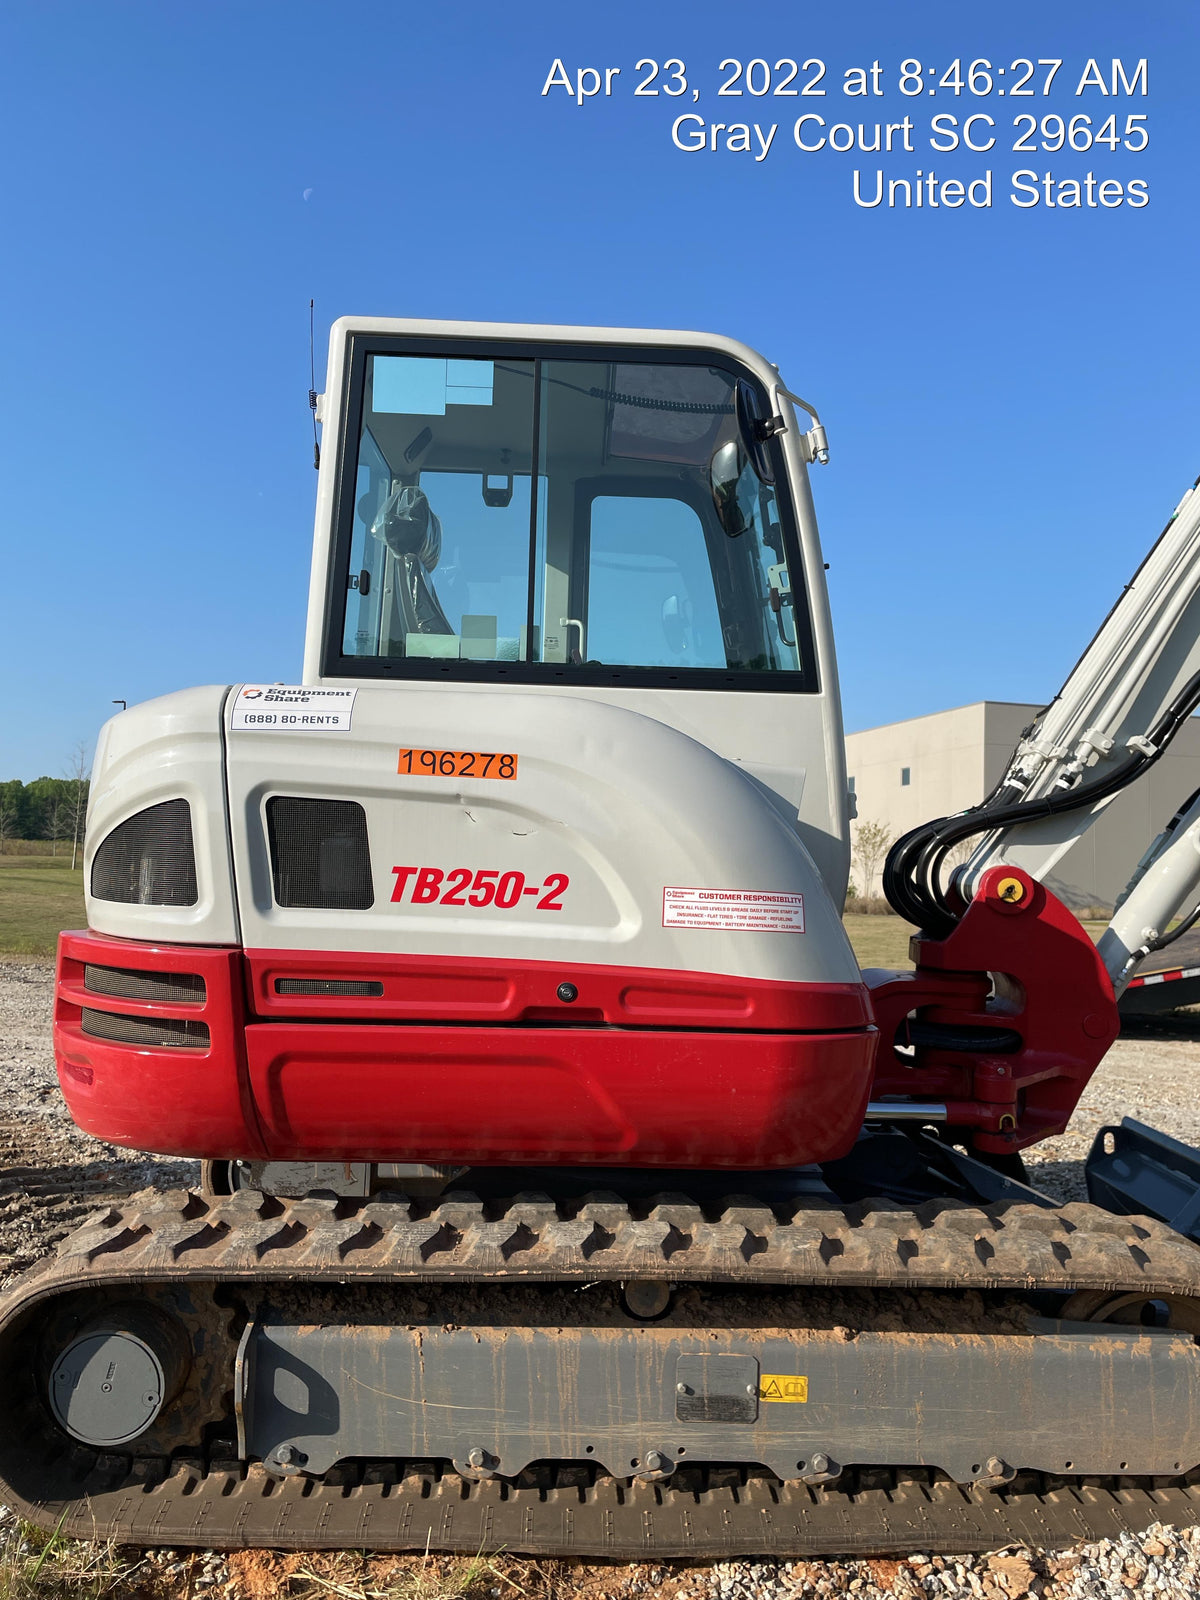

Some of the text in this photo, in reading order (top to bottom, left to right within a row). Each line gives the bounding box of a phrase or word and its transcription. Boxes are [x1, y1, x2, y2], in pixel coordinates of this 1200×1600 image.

[267, 688, 352, 697] Equipment
[264, 695, 310, 703] Share
[244, 714, 340, 725] (888) 80-RENTS
[402, 749, 515, 779] 196278
[390, 866, 570, 911] TB250-2
[699, 893, 802, 904] CUSTOMER RESPONSIBILITY
